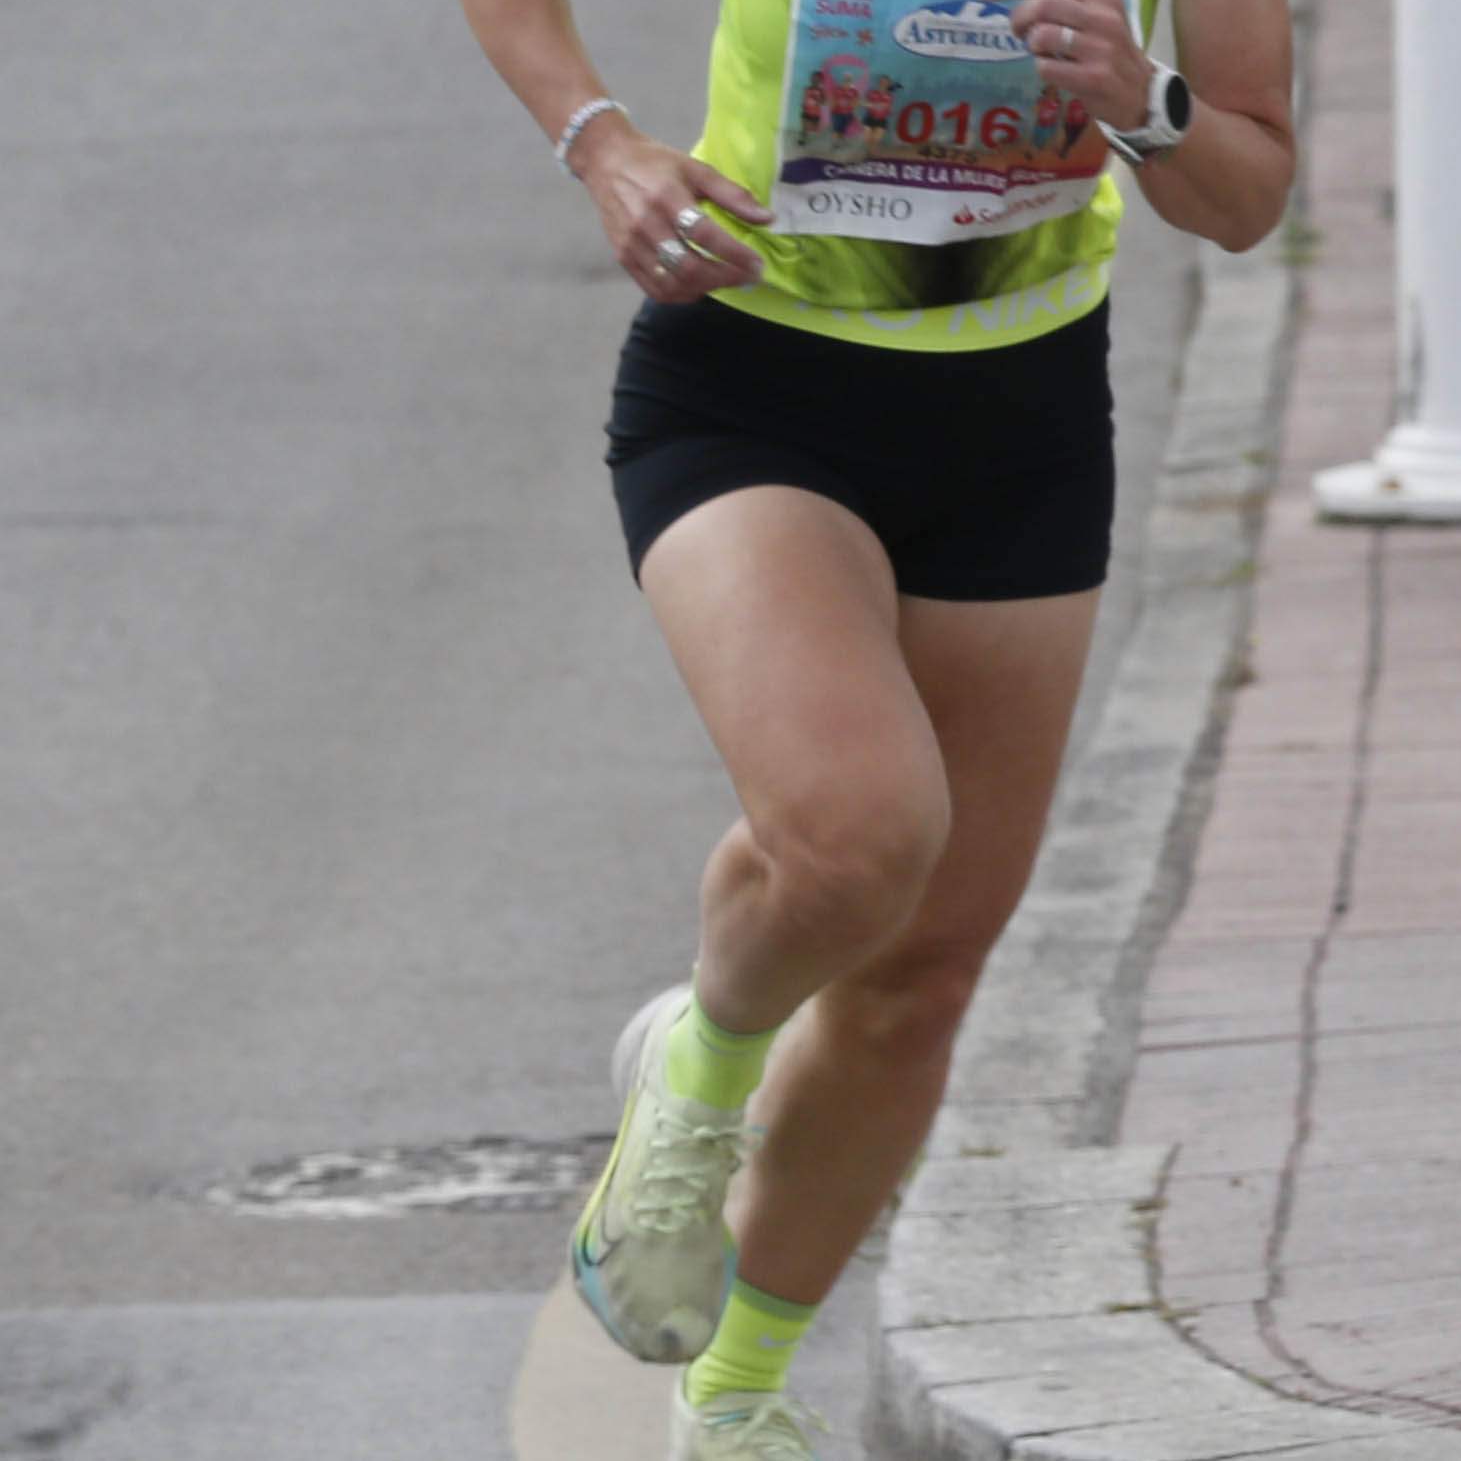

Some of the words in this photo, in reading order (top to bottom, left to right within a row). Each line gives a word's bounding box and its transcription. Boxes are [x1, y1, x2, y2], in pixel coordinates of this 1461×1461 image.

[904, 17, 1031, 51] ASTURIAN
[895, 100, 1022, 150] 016
[902, 164, 924, 182] DE
[927, 165, 949, 184] LA
[807, 191, 913, 222] OYSHO
